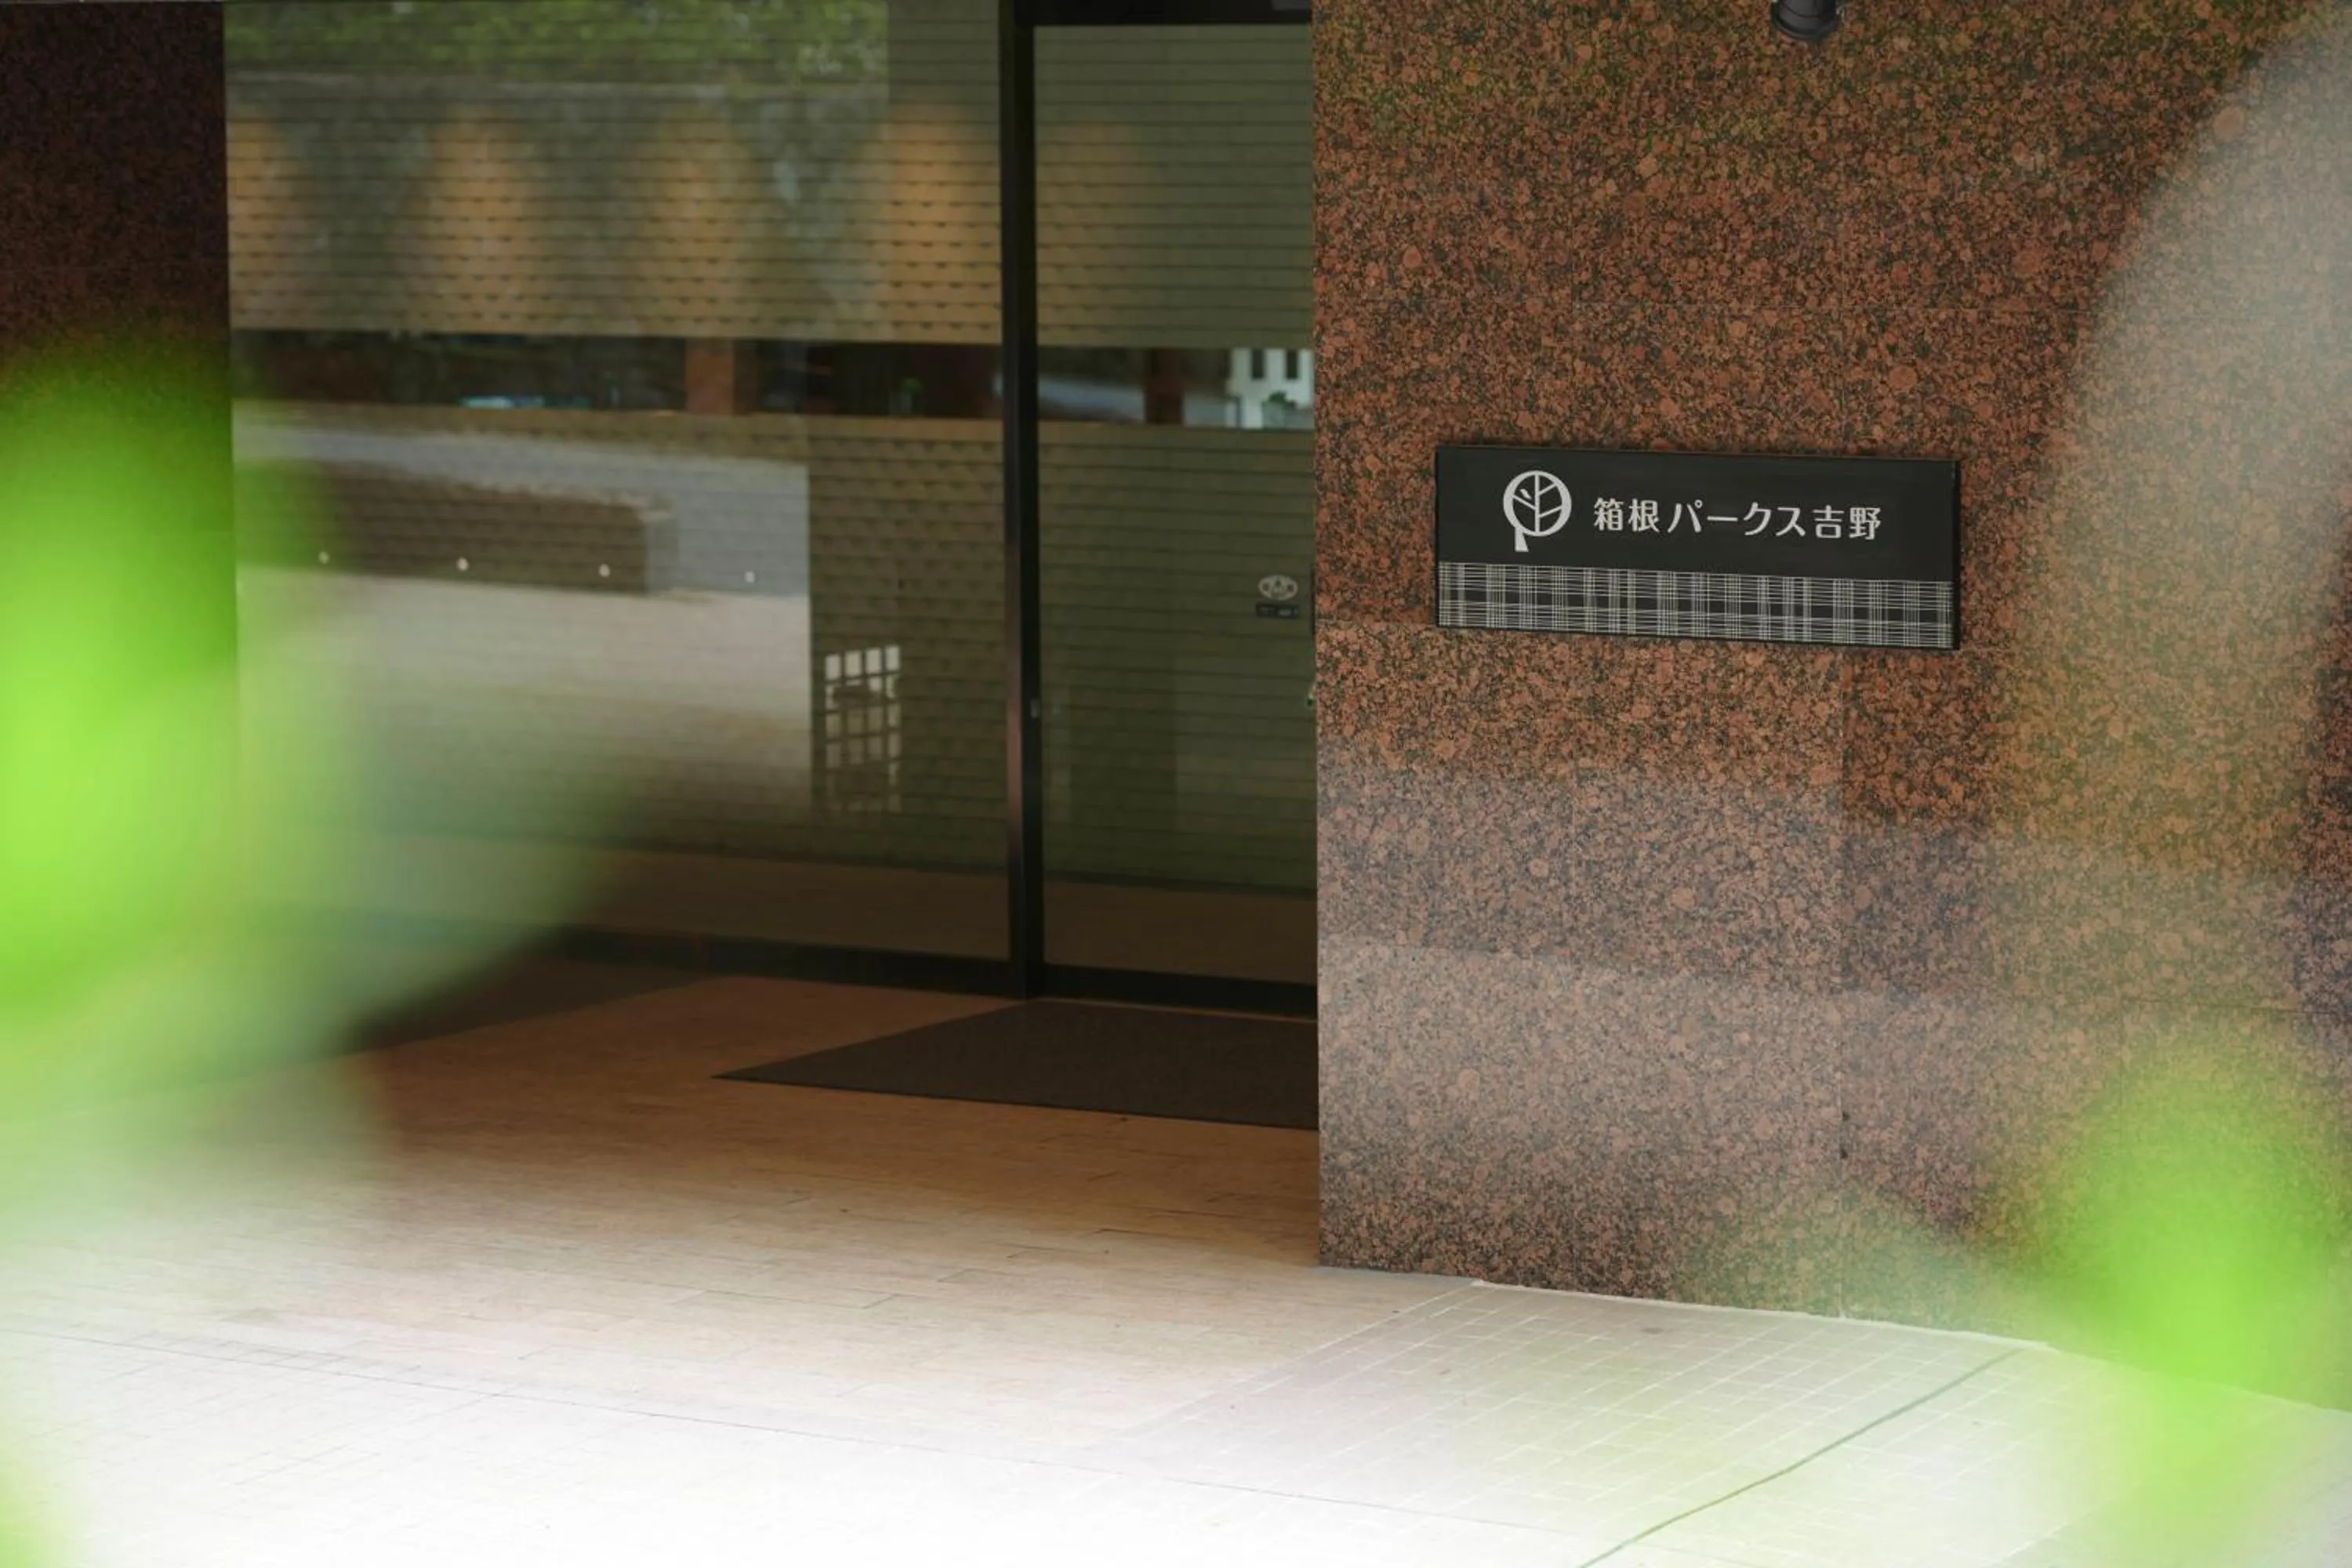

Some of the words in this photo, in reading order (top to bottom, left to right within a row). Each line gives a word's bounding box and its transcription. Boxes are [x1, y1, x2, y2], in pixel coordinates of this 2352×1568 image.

[1594, 497, 1882, 540] 箱根パークス吉野
